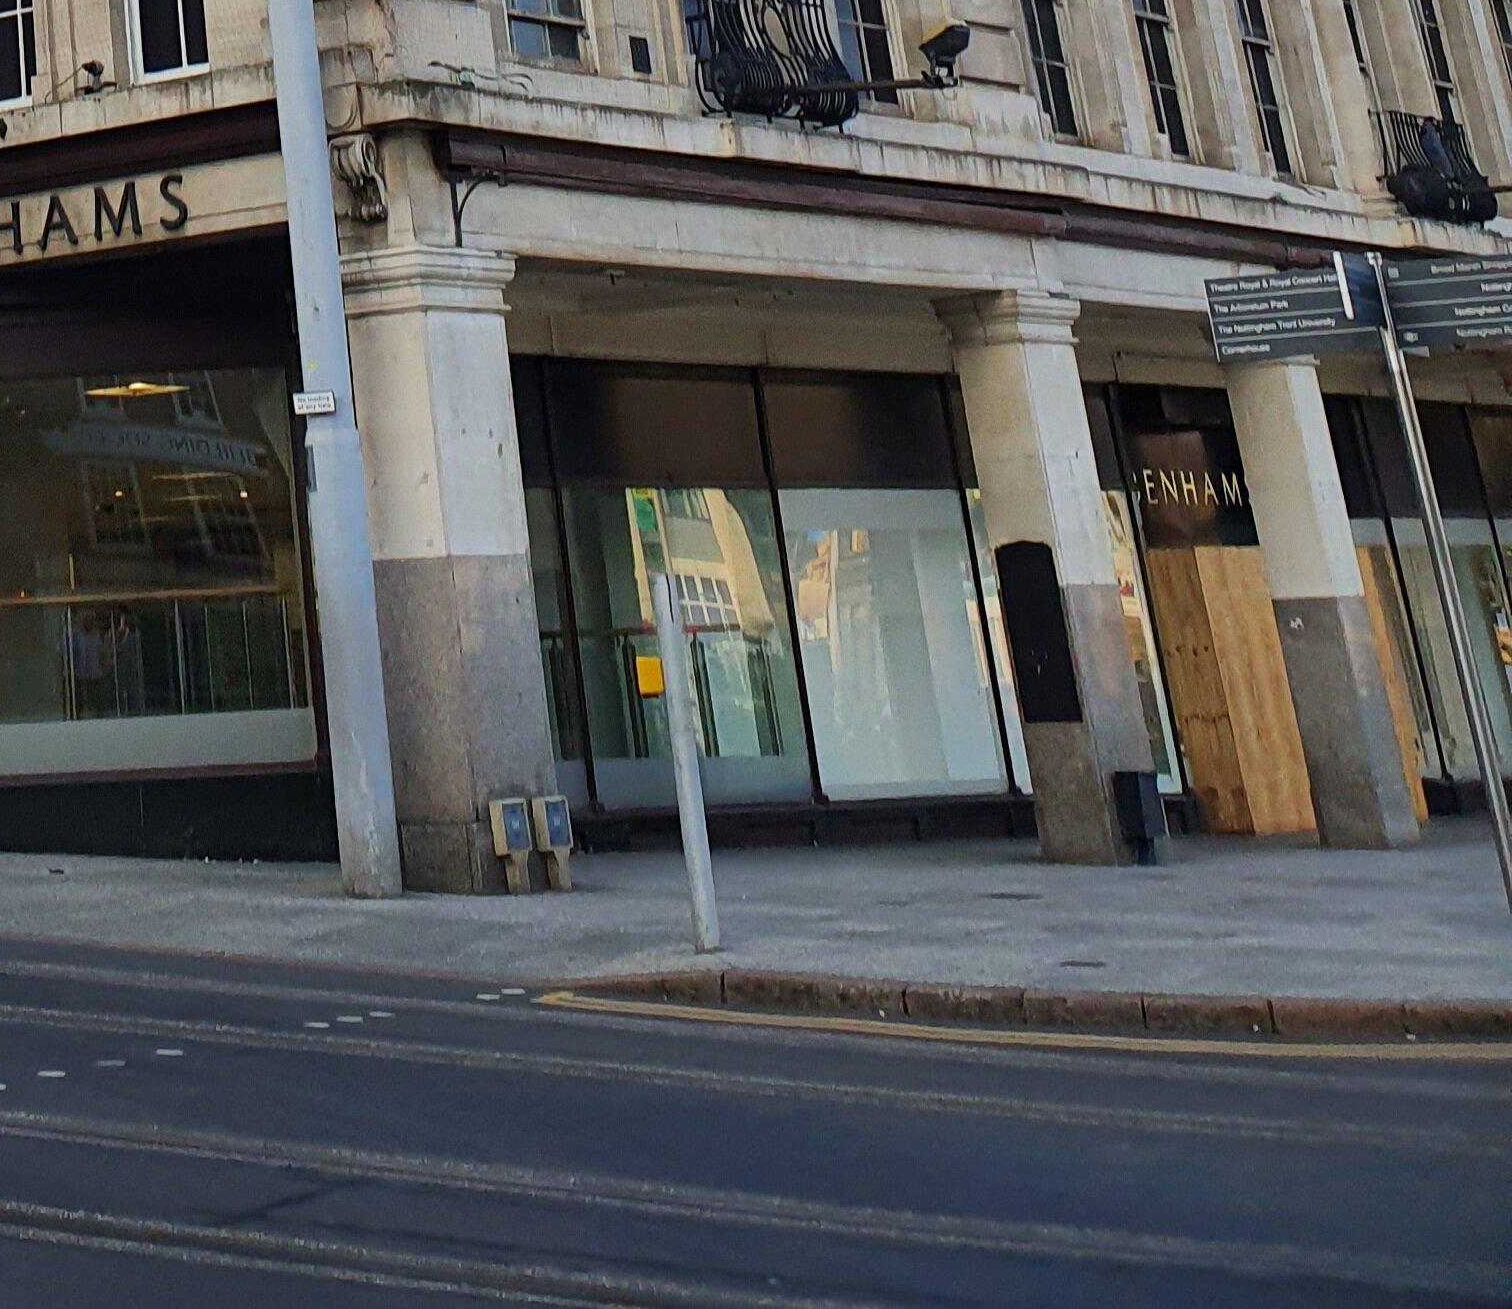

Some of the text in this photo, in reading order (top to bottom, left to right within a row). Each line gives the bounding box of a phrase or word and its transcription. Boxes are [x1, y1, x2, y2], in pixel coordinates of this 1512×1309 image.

[1291, 274, 1322, 286] Concert
[1269, 299, 1289, 310] Park
[1297, 317, 1336, 328] University
[1132, 468, 1243, 507] ENHAM
